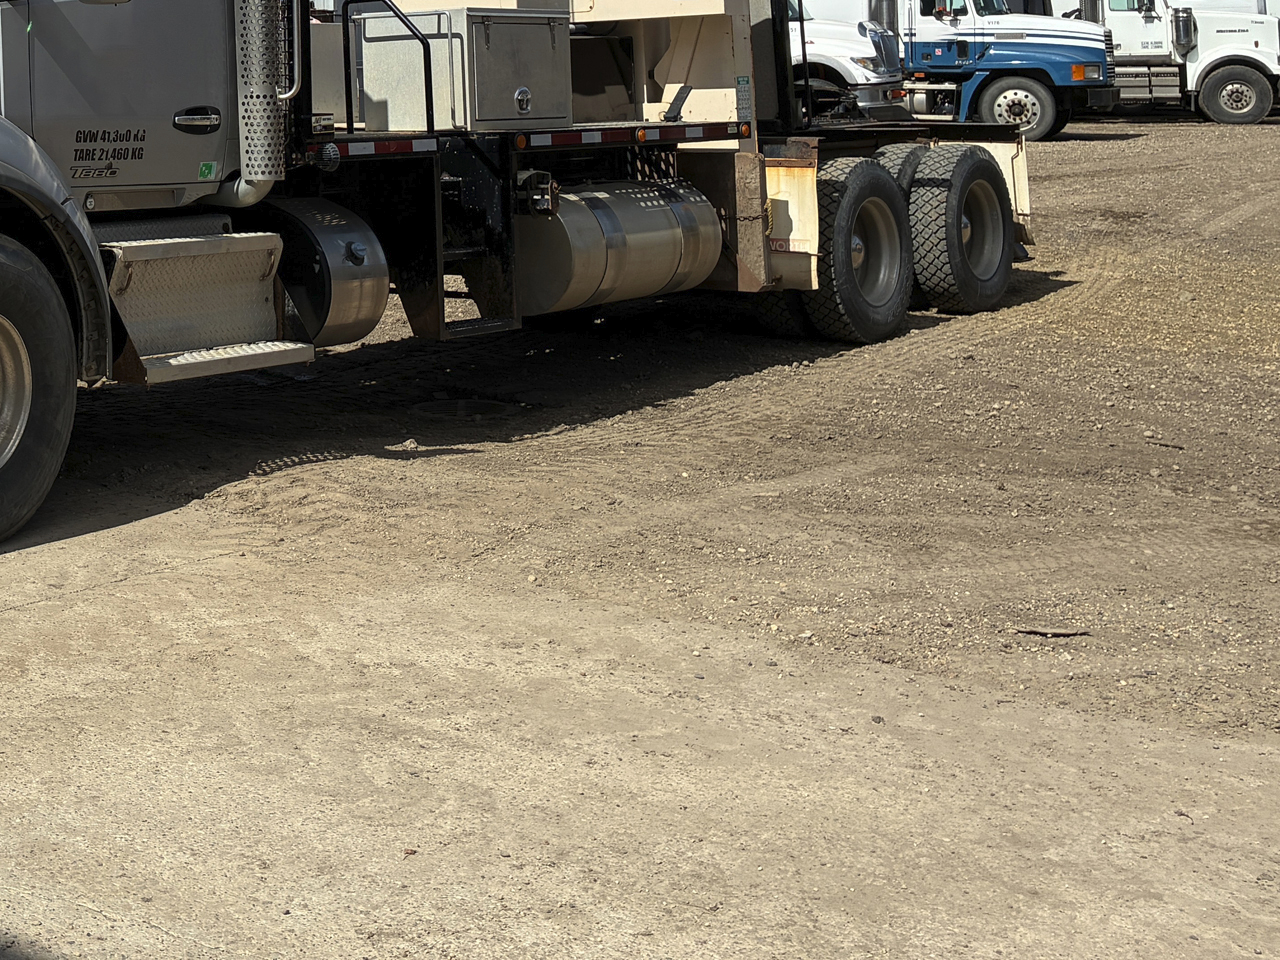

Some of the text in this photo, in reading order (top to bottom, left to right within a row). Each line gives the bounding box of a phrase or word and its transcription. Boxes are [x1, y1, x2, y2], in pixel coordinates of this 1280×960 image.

[75, 129, 99, 143] GVW
[73, 148, 96, 162] TARE
[130, 147, 144, 160] KG
[70, 166, 120, 179] T880
